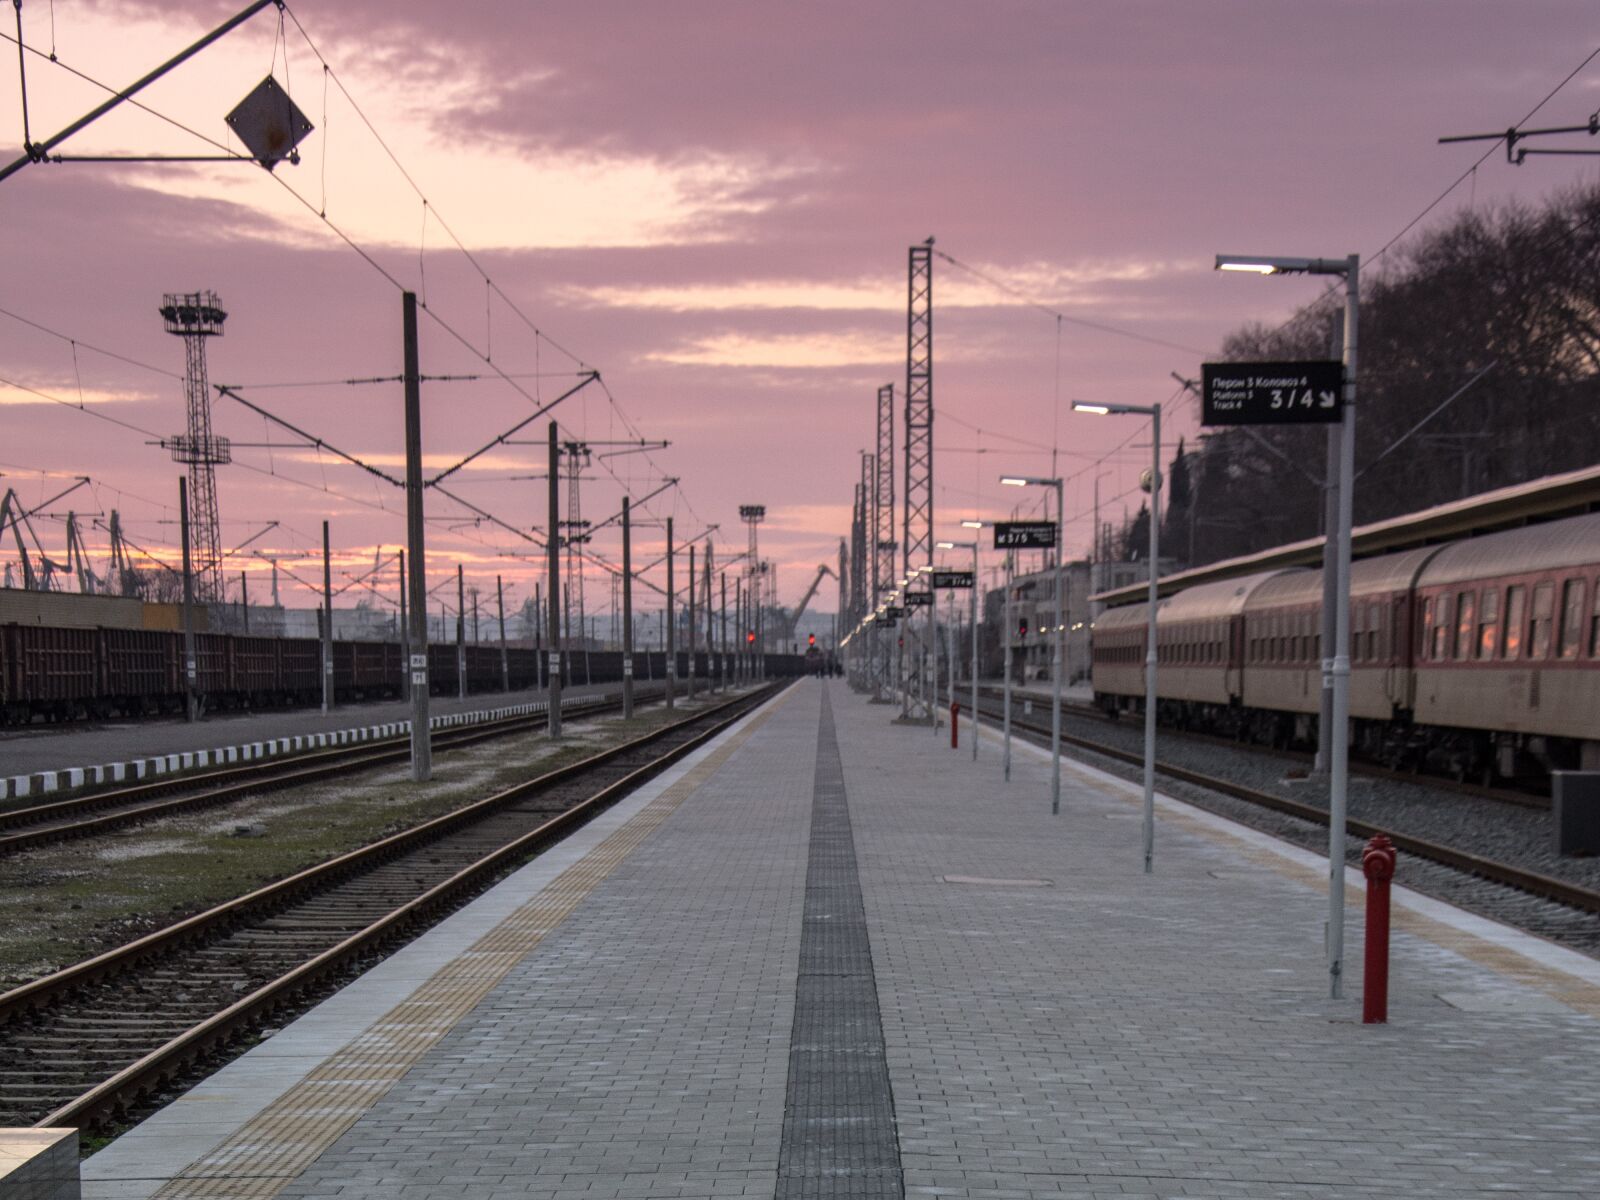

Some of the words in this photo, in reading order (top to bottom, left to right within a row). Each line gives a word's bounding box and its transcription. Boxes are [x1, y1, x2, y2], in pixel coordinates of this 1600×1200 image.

[1212, 377, 1245, 389] Перон
[1247, 377, 1254, 388] 3
[1300, 376, 1307, 387] 4
[1213, 390, 1246, 400] Platform
[1247, 390, 1254, 400] 3
[1270, 389, 1283, 409] 3
[1300, 389, 1314, 409] 4
[1213, 400, 1235, 410] Track
[1236, 400, 1242, 410] 4
